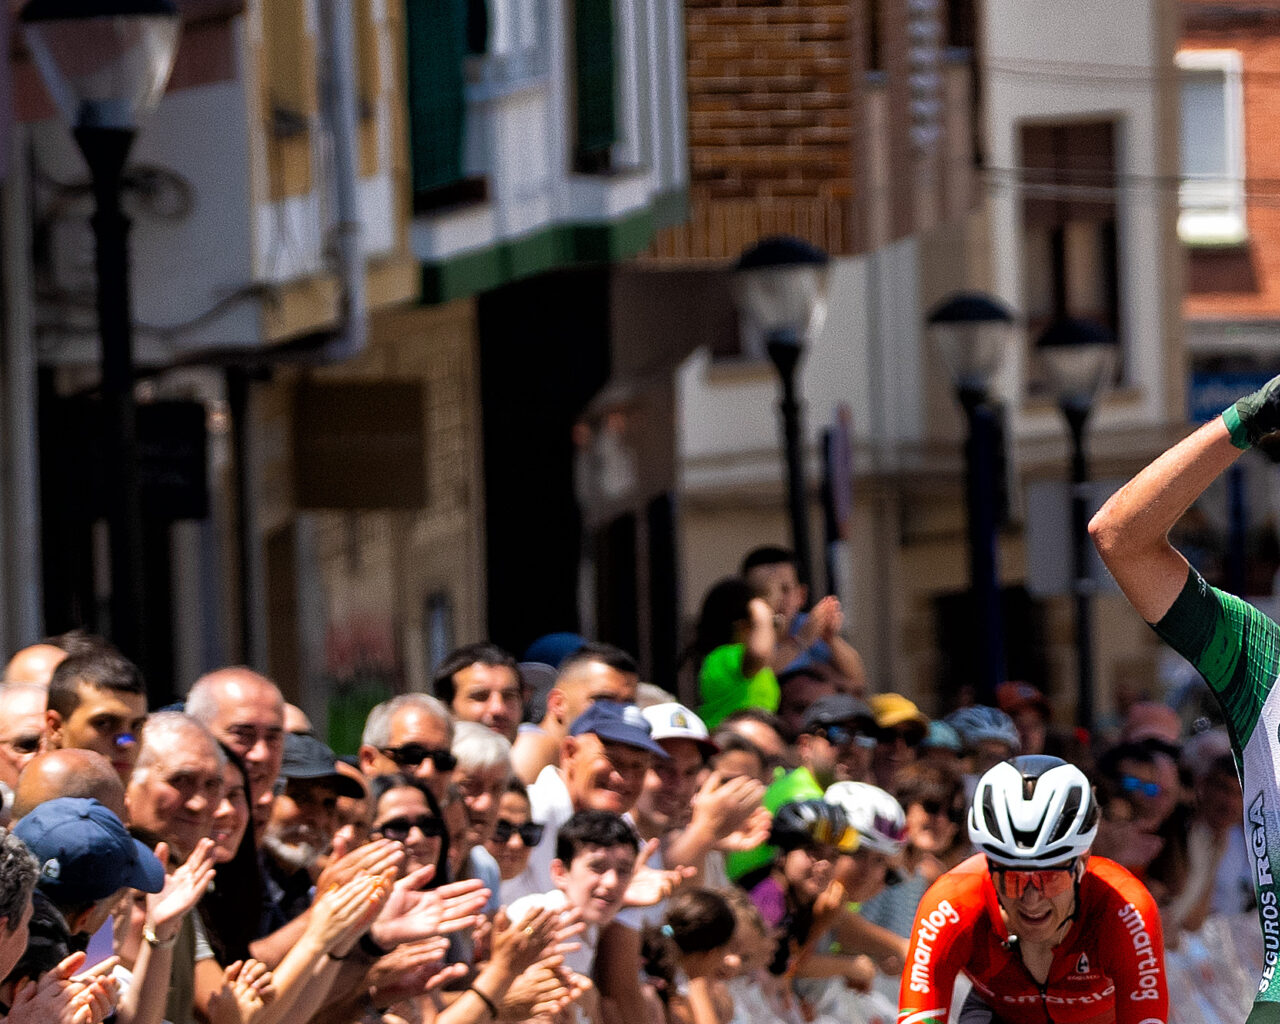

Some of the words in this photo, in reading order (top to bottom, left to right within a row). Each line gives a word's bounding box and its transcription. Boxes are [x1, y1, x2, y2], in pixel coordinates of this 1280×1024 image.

[1249, 790, 1274, 886] RGA
[909, 899, 960, 994] smartlog
[1117, 902, 1160, 1002] smartlog
[1258, 890, 1279, 993] SEGUROS
[1003, 985, 1116, 1005] smartlo
